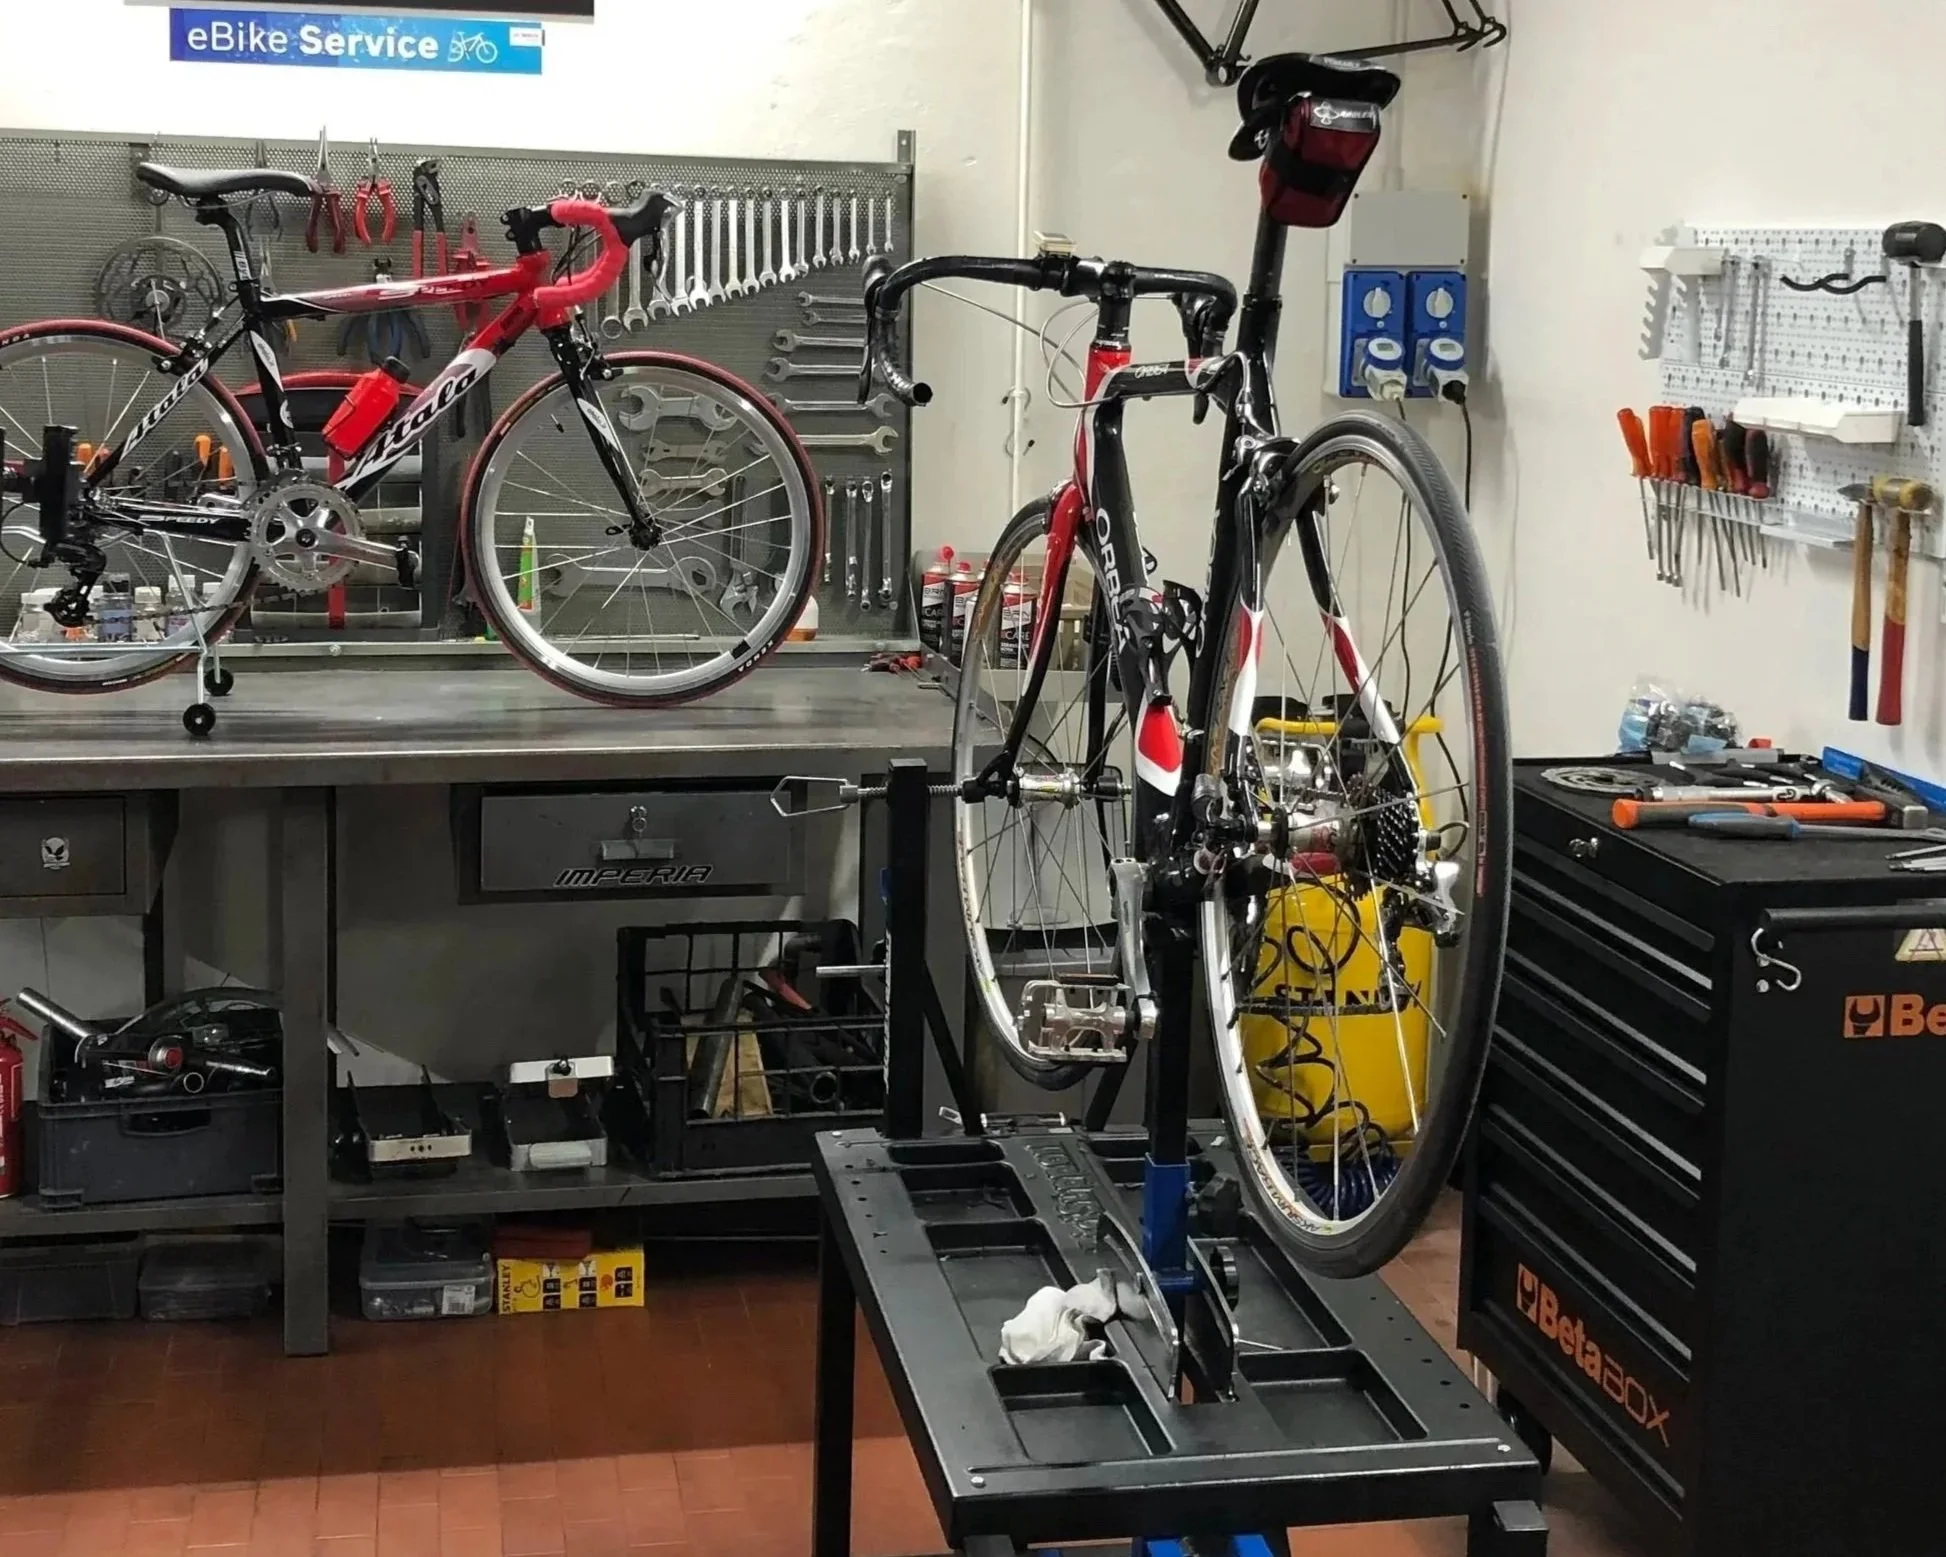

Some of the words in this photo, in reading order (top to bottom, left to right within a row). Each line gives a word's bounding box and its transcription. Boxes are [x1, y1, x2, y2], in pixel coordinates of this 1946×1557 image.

[187, 21, 288, 53] eBike
[299, 25, 438, 60] Service
[139, 514, 222, 524] SPEEDY
[553, 863, 714, 888] IMPERIA
[502, 1264, 511, 1313] STANLEY
